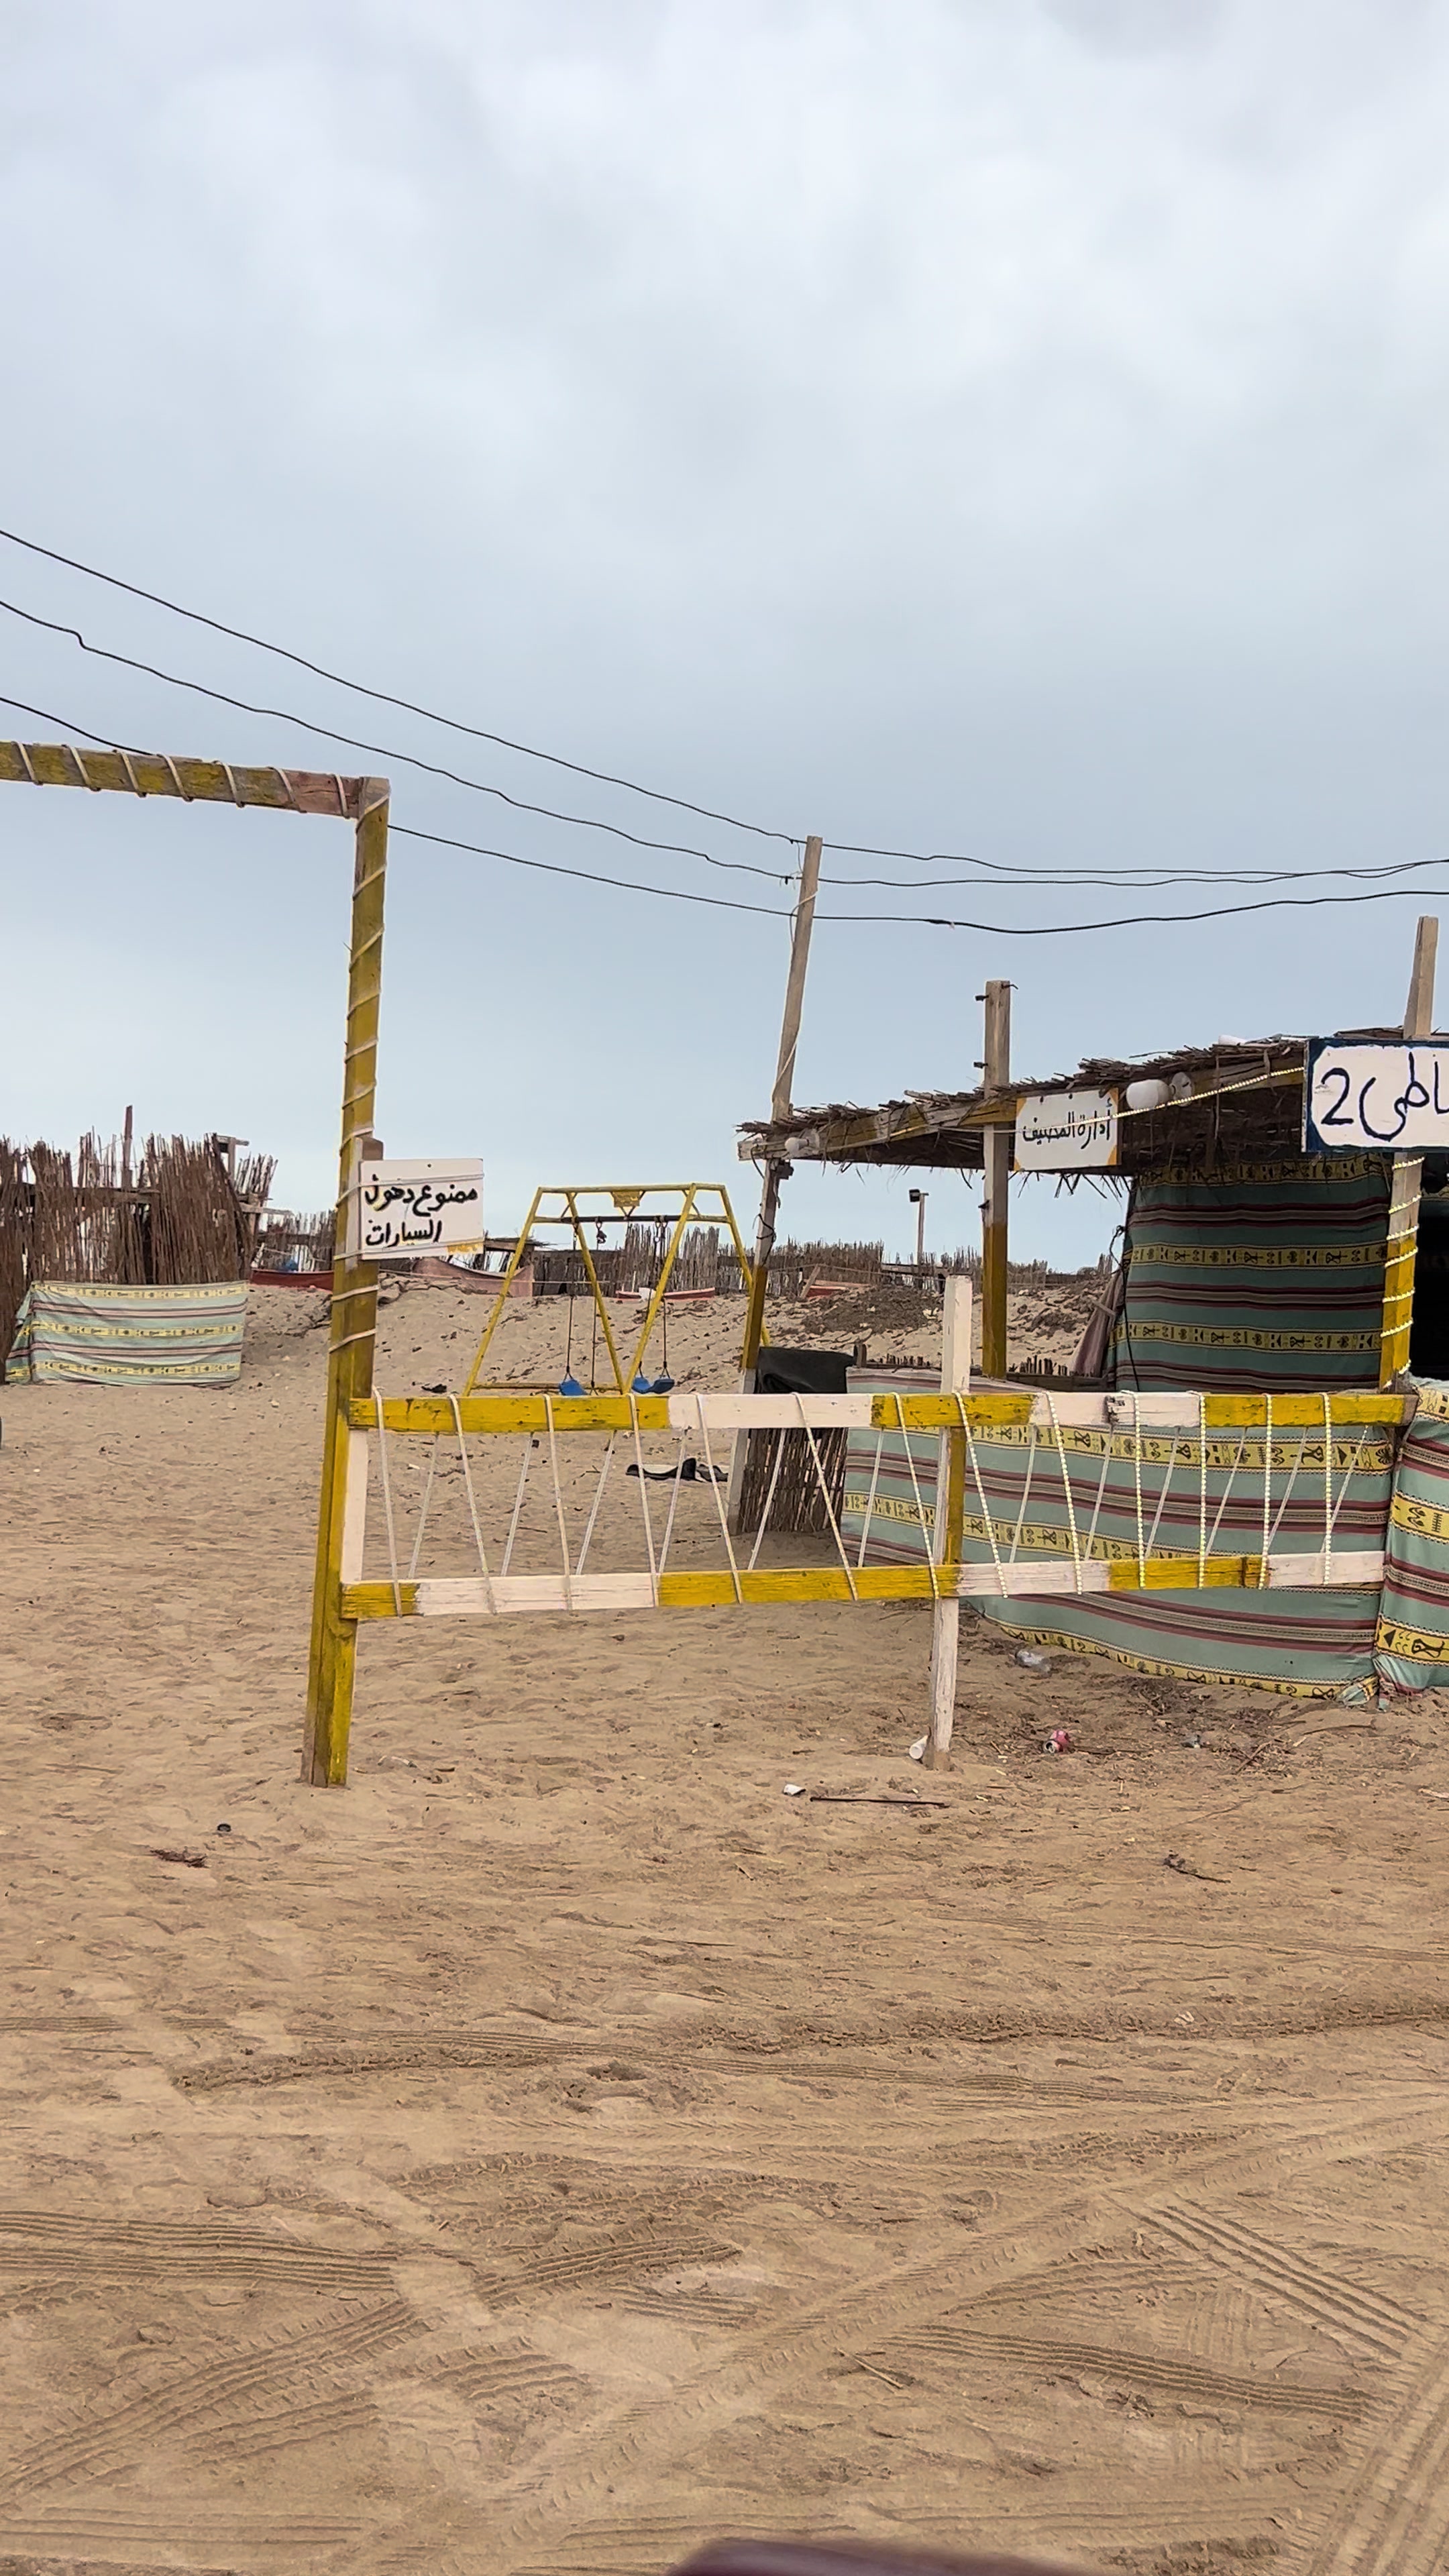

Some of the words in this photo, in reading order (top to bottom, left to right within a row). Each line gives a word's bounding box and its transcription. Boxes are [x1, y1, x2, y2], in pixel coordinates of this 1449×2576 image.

[1320, 1067, 1354, 1125] 2
[1022, 1110, 1075, 1144] المصيف
[364, 1174, 415, 1212] دخول
[413, 1184, 478, 1217] ممنوع
[365, 1219, 443, 1248] السيارات
